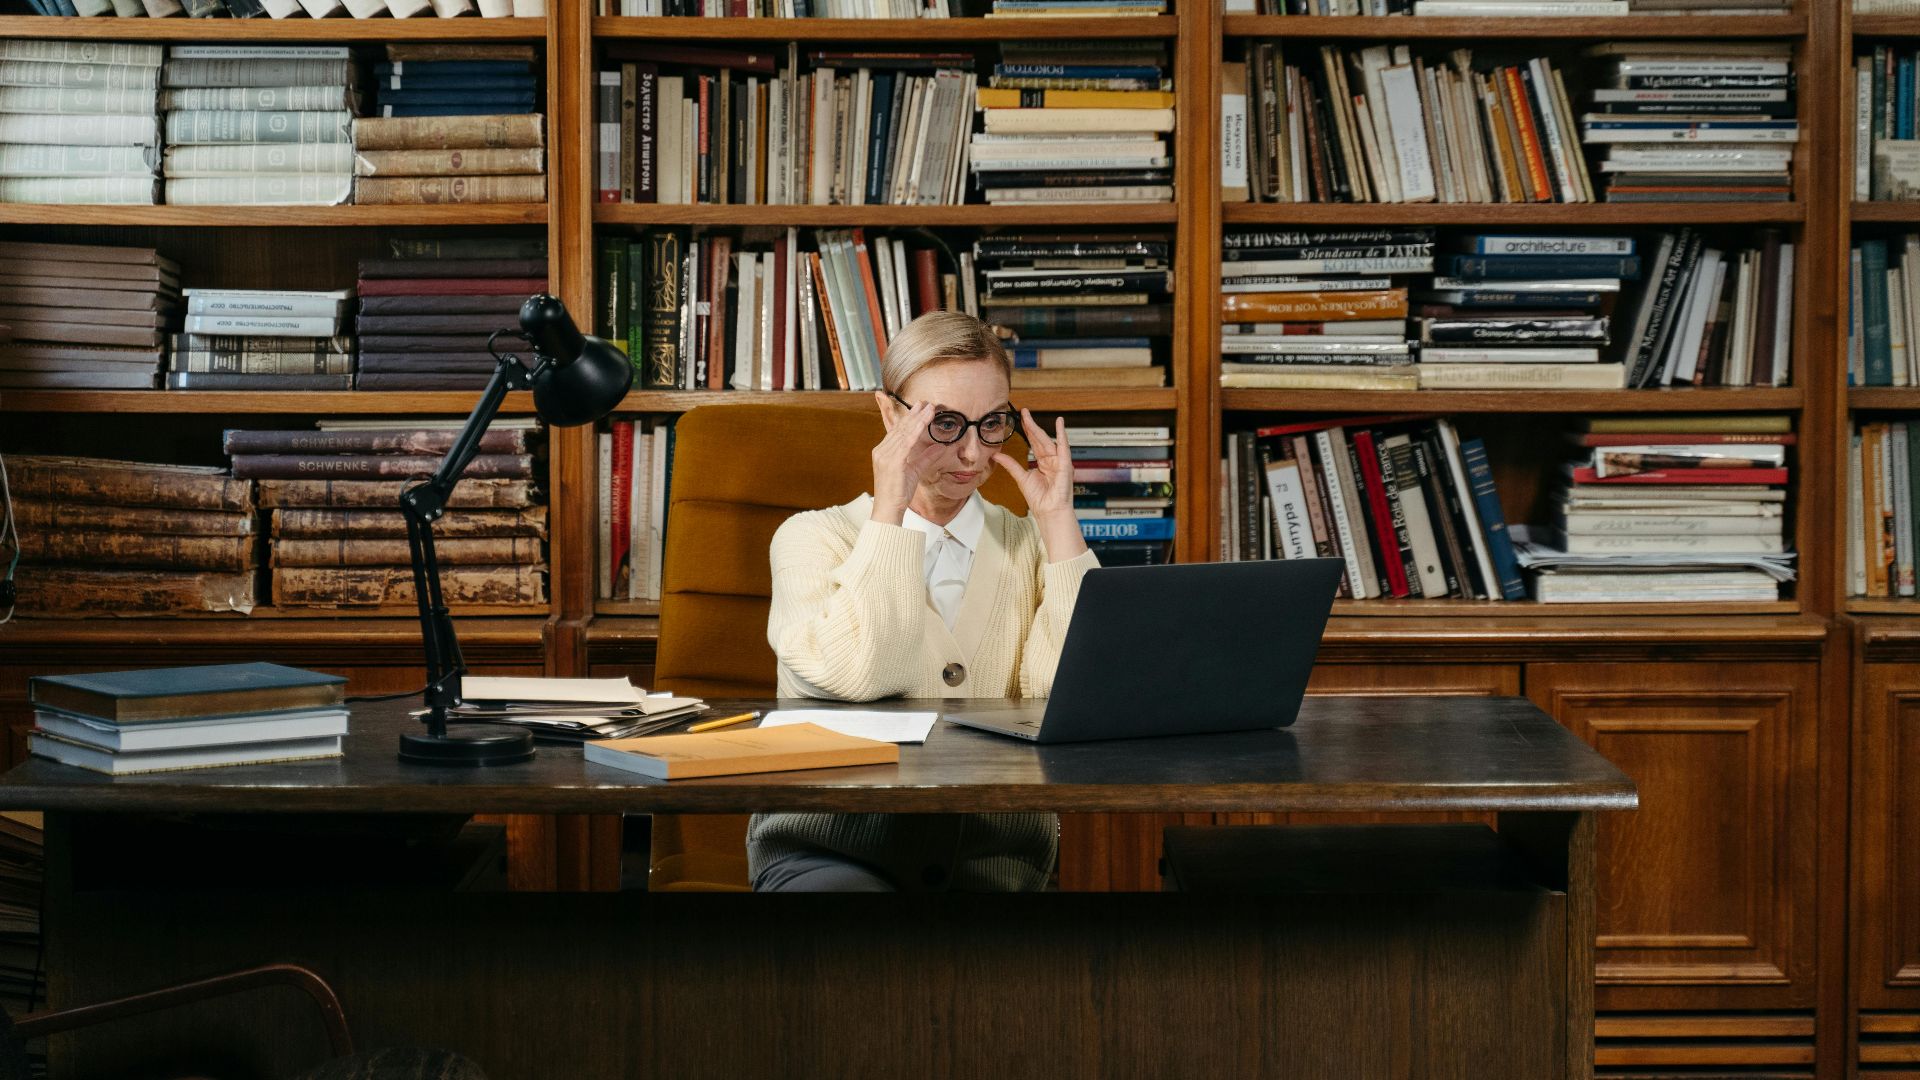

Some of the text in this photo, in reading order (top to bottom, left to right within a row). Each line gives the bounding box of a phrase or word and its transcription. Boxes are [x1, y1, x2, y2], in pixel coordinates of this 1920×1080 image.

[1224, 115, 1233, 167] Беларуси
[1234, 113, 1243, 170] Искусство
[1224, 231, 1393, 247] Splendeurs de VERSAILLES
[1505, 239, 1586, 253] architecture
[1669, 227, 1690, 267] Roman
[1299, 245, 1431, 261] Splendeurs de PARIS
[1663, 268, 1677, 286] Art
[1268, 300, 1398, 312] DIE MOSAIKEN VON ROM
[1377, 443, 1411, 552] Les Rois de France
[1083, 524, 1139, 538] НЕЦОВ
[1284, 502, 1303, 559] ьптура
